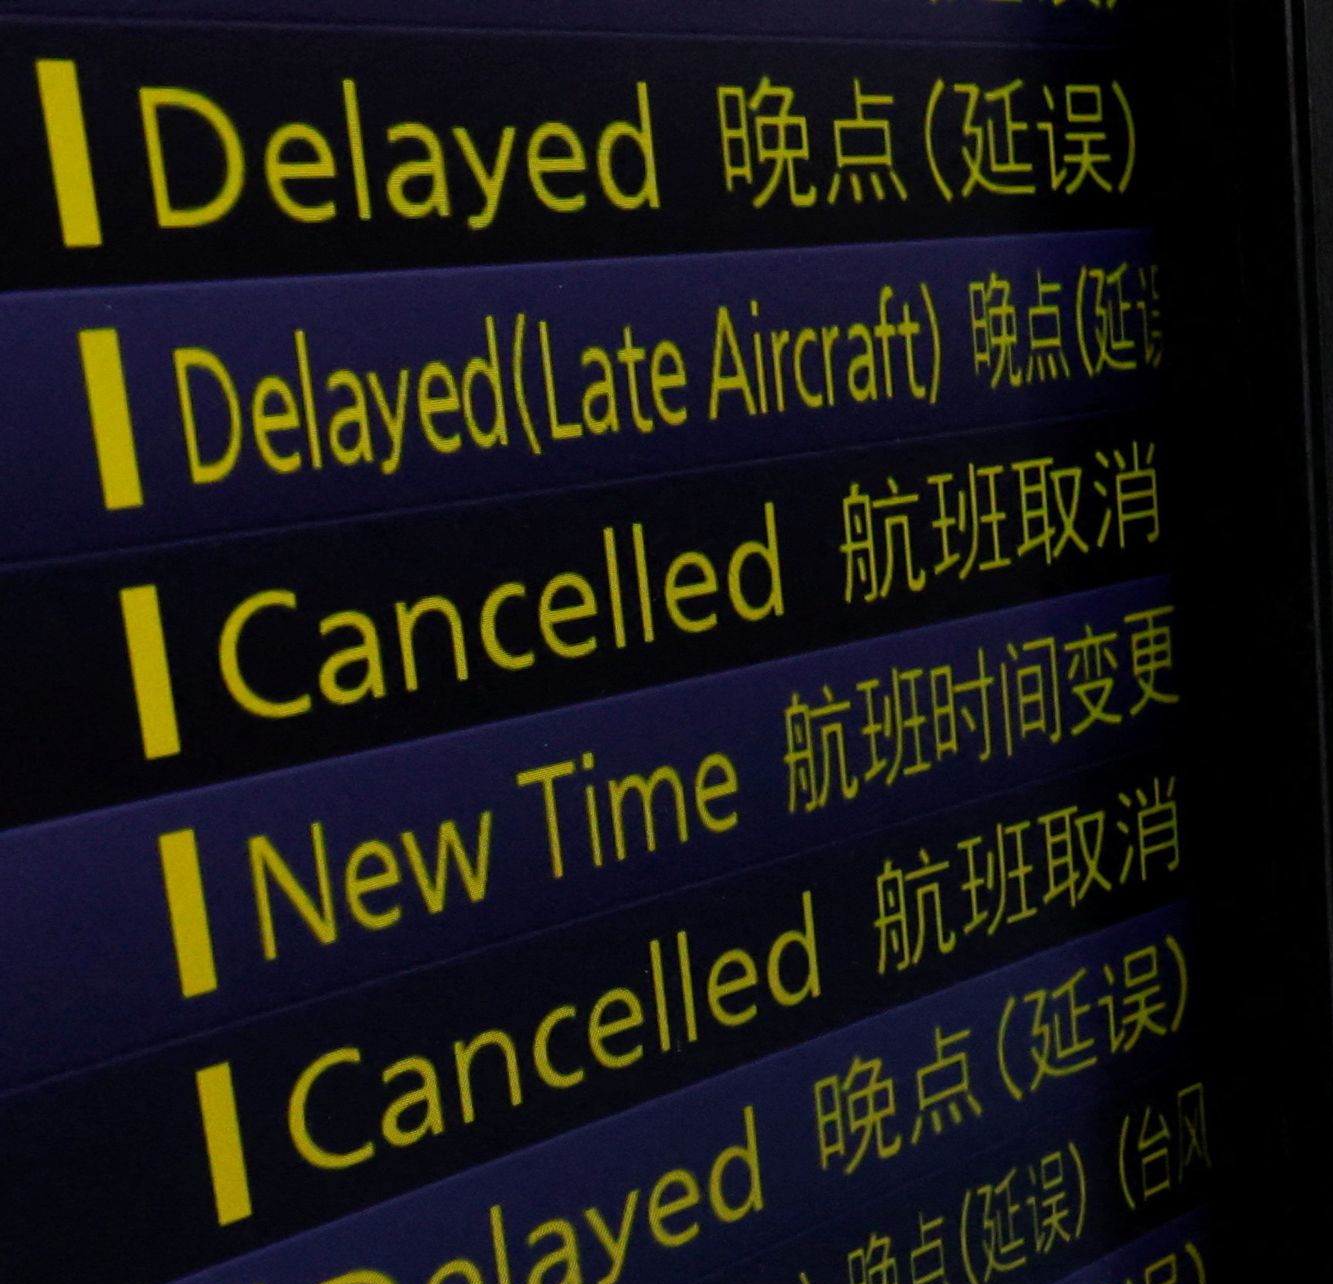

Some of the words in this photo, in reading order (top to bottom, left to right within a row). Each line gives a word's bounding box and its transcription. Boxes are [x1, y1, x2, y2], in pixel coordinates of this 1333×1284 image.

[139, 79, 661, 231] Delayed
[718, 76, 1136, 209] 晚点(延误)
[173, 314, 688, 486] Delayed(Late
[710, 284, 942, 421] Aircraft)
[220, 503, 785, 719] Cancelled
[839, 441, 1161, 605] 航班取消
[248, 812, 493, 961] New
[517, 753, 739, 878] Time
[783, 605, 1180, 813] 航班时间变更
[289, 892, 822, 1170] Cancelled
[874, 777, 1181, 975] 航班取消
[814, 936, 1189, 1176] 晚点(延误)
